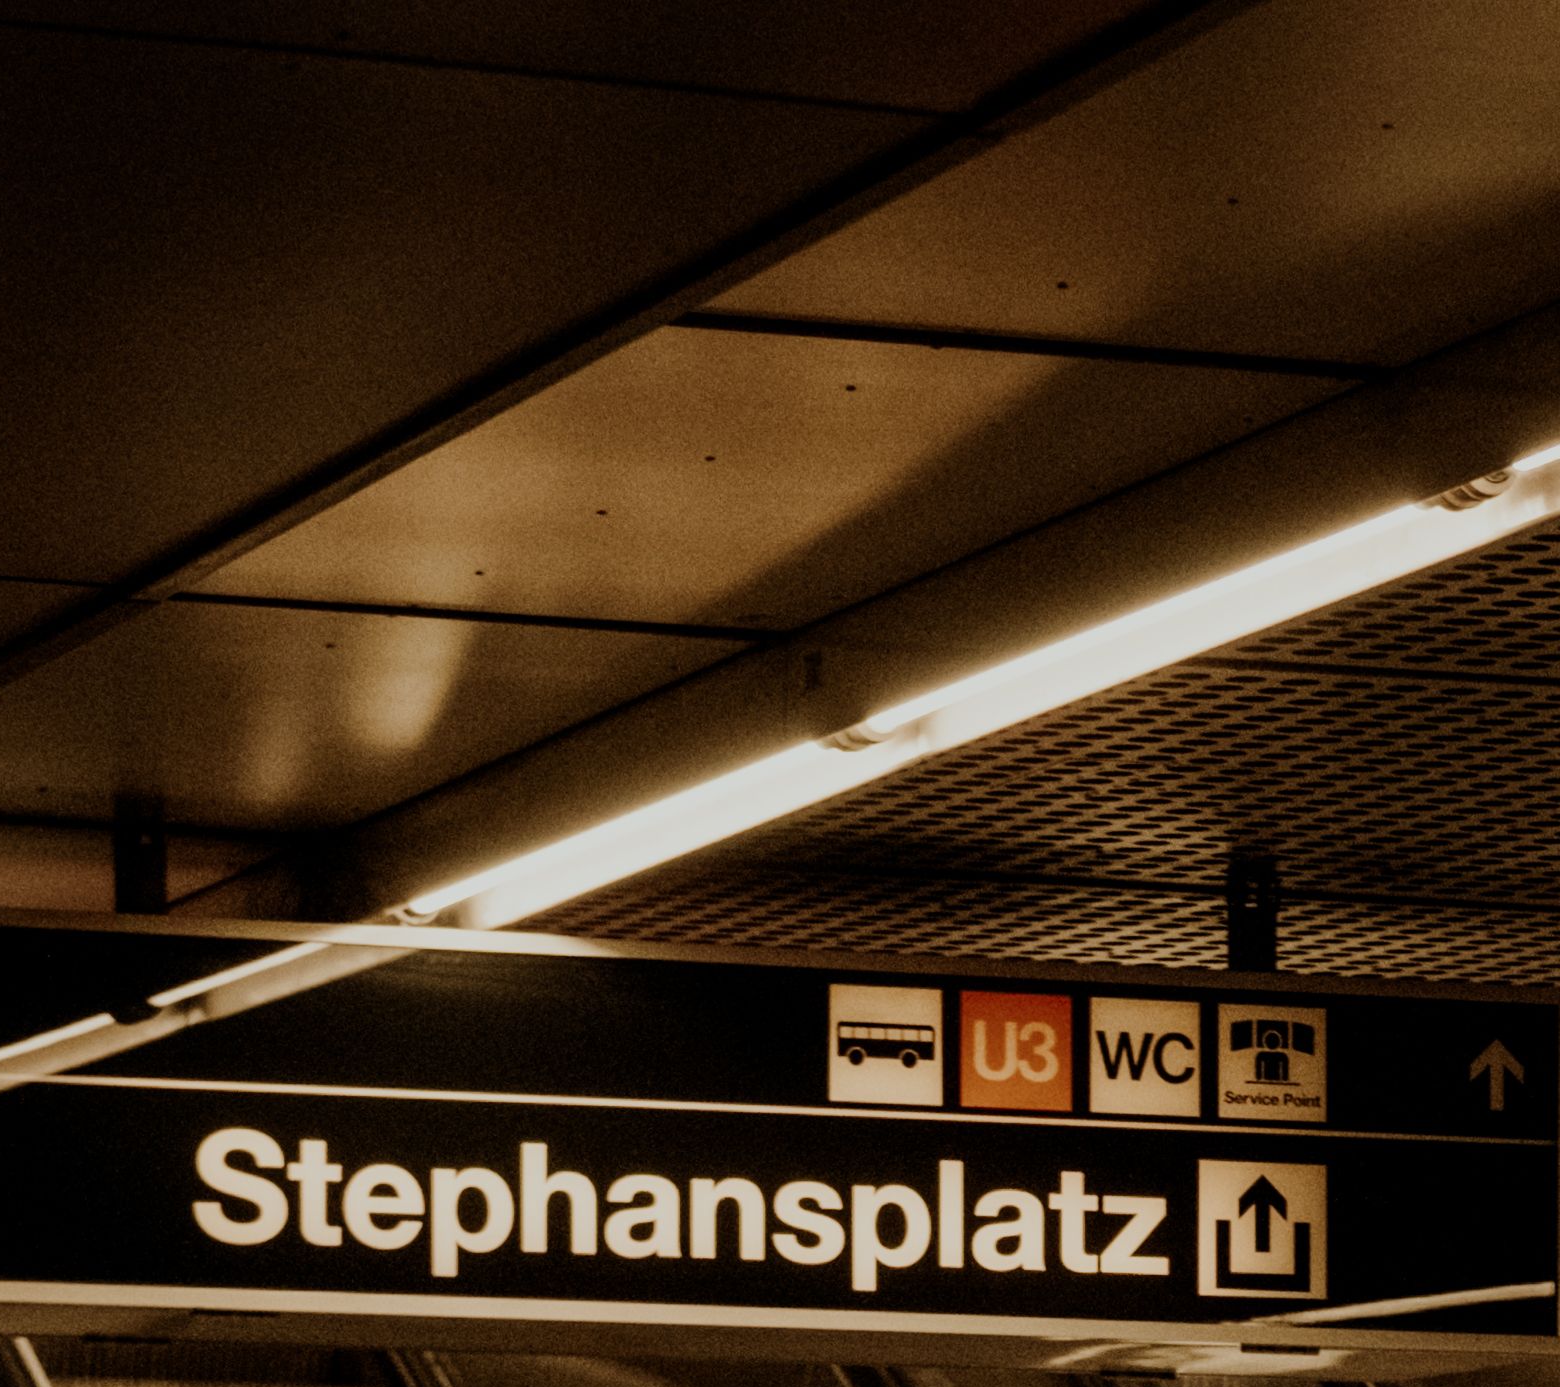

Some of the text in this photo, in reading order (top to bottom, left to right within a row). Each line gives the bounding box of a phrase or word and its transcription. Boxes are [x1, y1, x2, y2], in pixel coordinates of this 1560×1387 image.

[973, 1020, 1059, 1083] U3
[1096, 1031, 1195, 1085] WC
[1223, 1090, 1322, 1108] Service Point
[191, 1126, 1171, 1293] Stephansplatz
